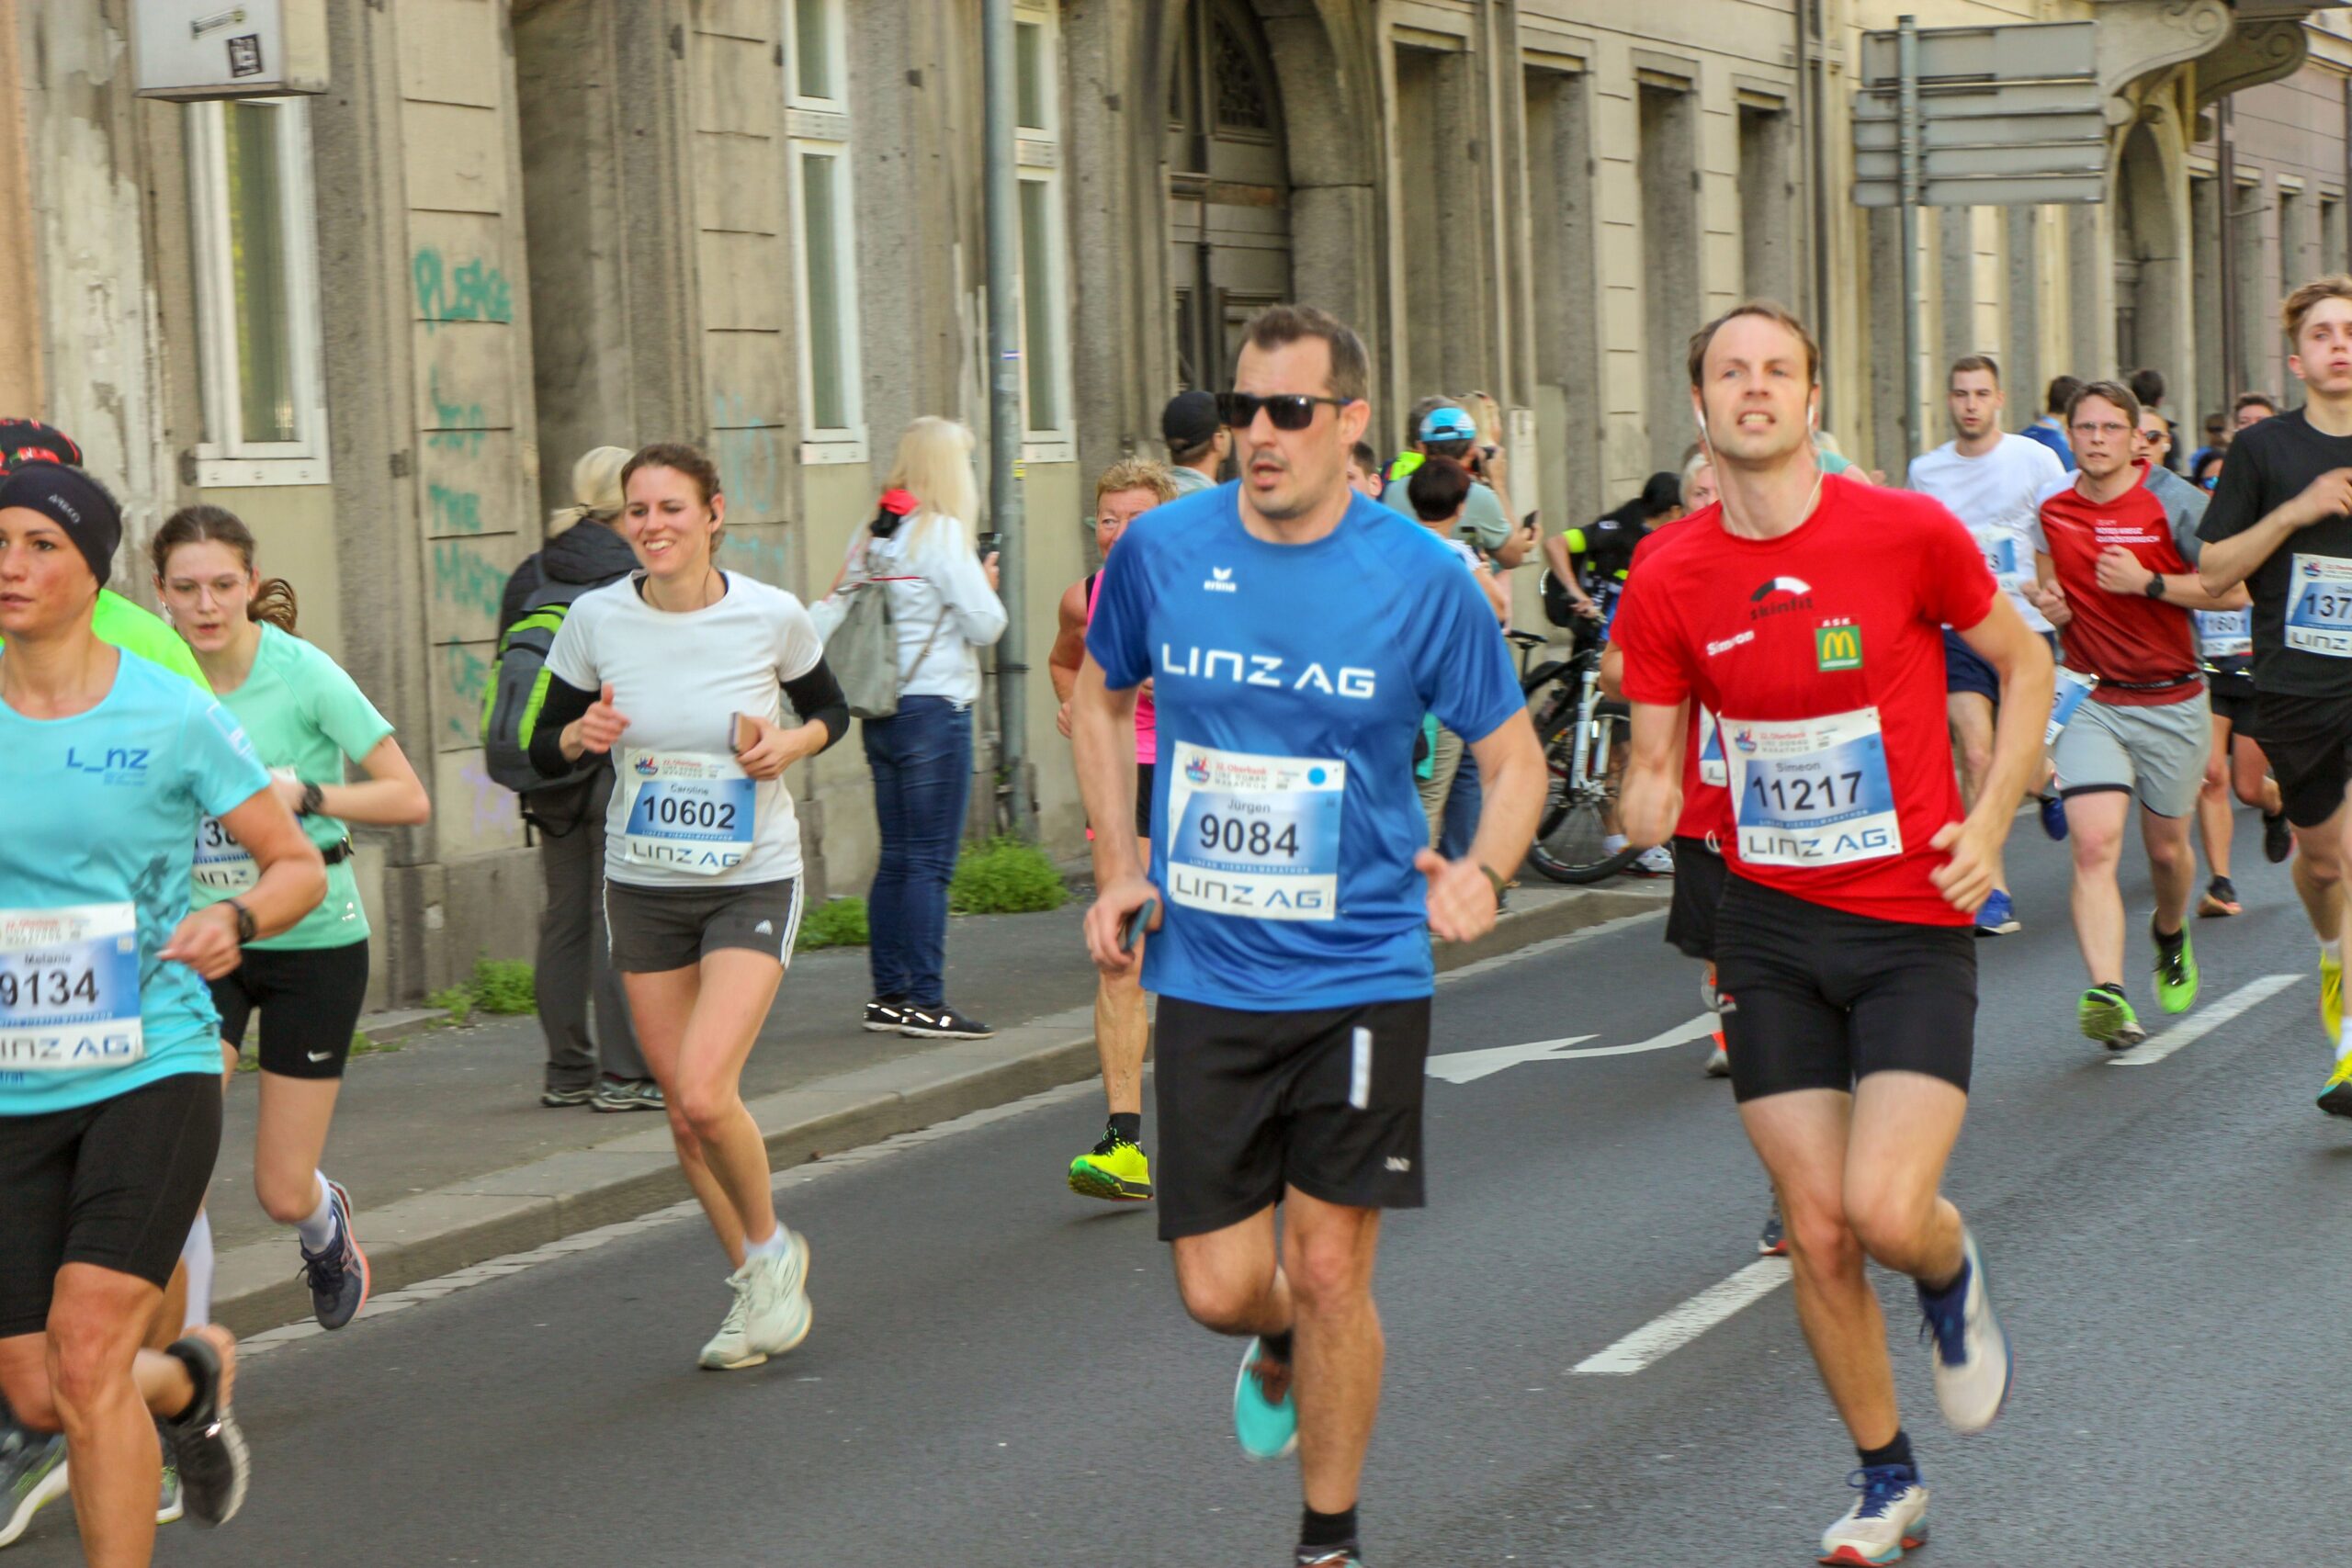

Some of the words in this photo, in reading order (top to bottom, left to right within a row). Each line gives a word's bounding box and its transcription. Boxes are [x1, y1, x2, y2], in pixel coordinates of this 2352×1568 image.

[1204, 580, 1238, 592] erima
[2306, 592, 2352, 620] 137
[1161, 642, 1283, 687] LINZ
[1293, 662, 1376, 699] AG
[1775, 761, 1822, 773] Simeon
[670, 782, 709, 796] Caroline
[1753, 771, 1863, 811] 11217
[643, 795, 736, 830] 10602
[1227, 797, 1272, 815] Jürgen
[1200, 814, 1300, 858] 9084
[1748, 834, 1824, 858] LINZ
[1833, 828, 1888, 854] AG
[632, 841, 693, 864] LINZ
[699, 851, 742, 868] AG
[1176, 873, 1255, 906] LINZ
[1263, 888, 1322, 908] AG
[0, 966, 100, 1008] 9134
[0, 1036, 62, 1059] INZ
[73, 1034, 130, 1058] AG
